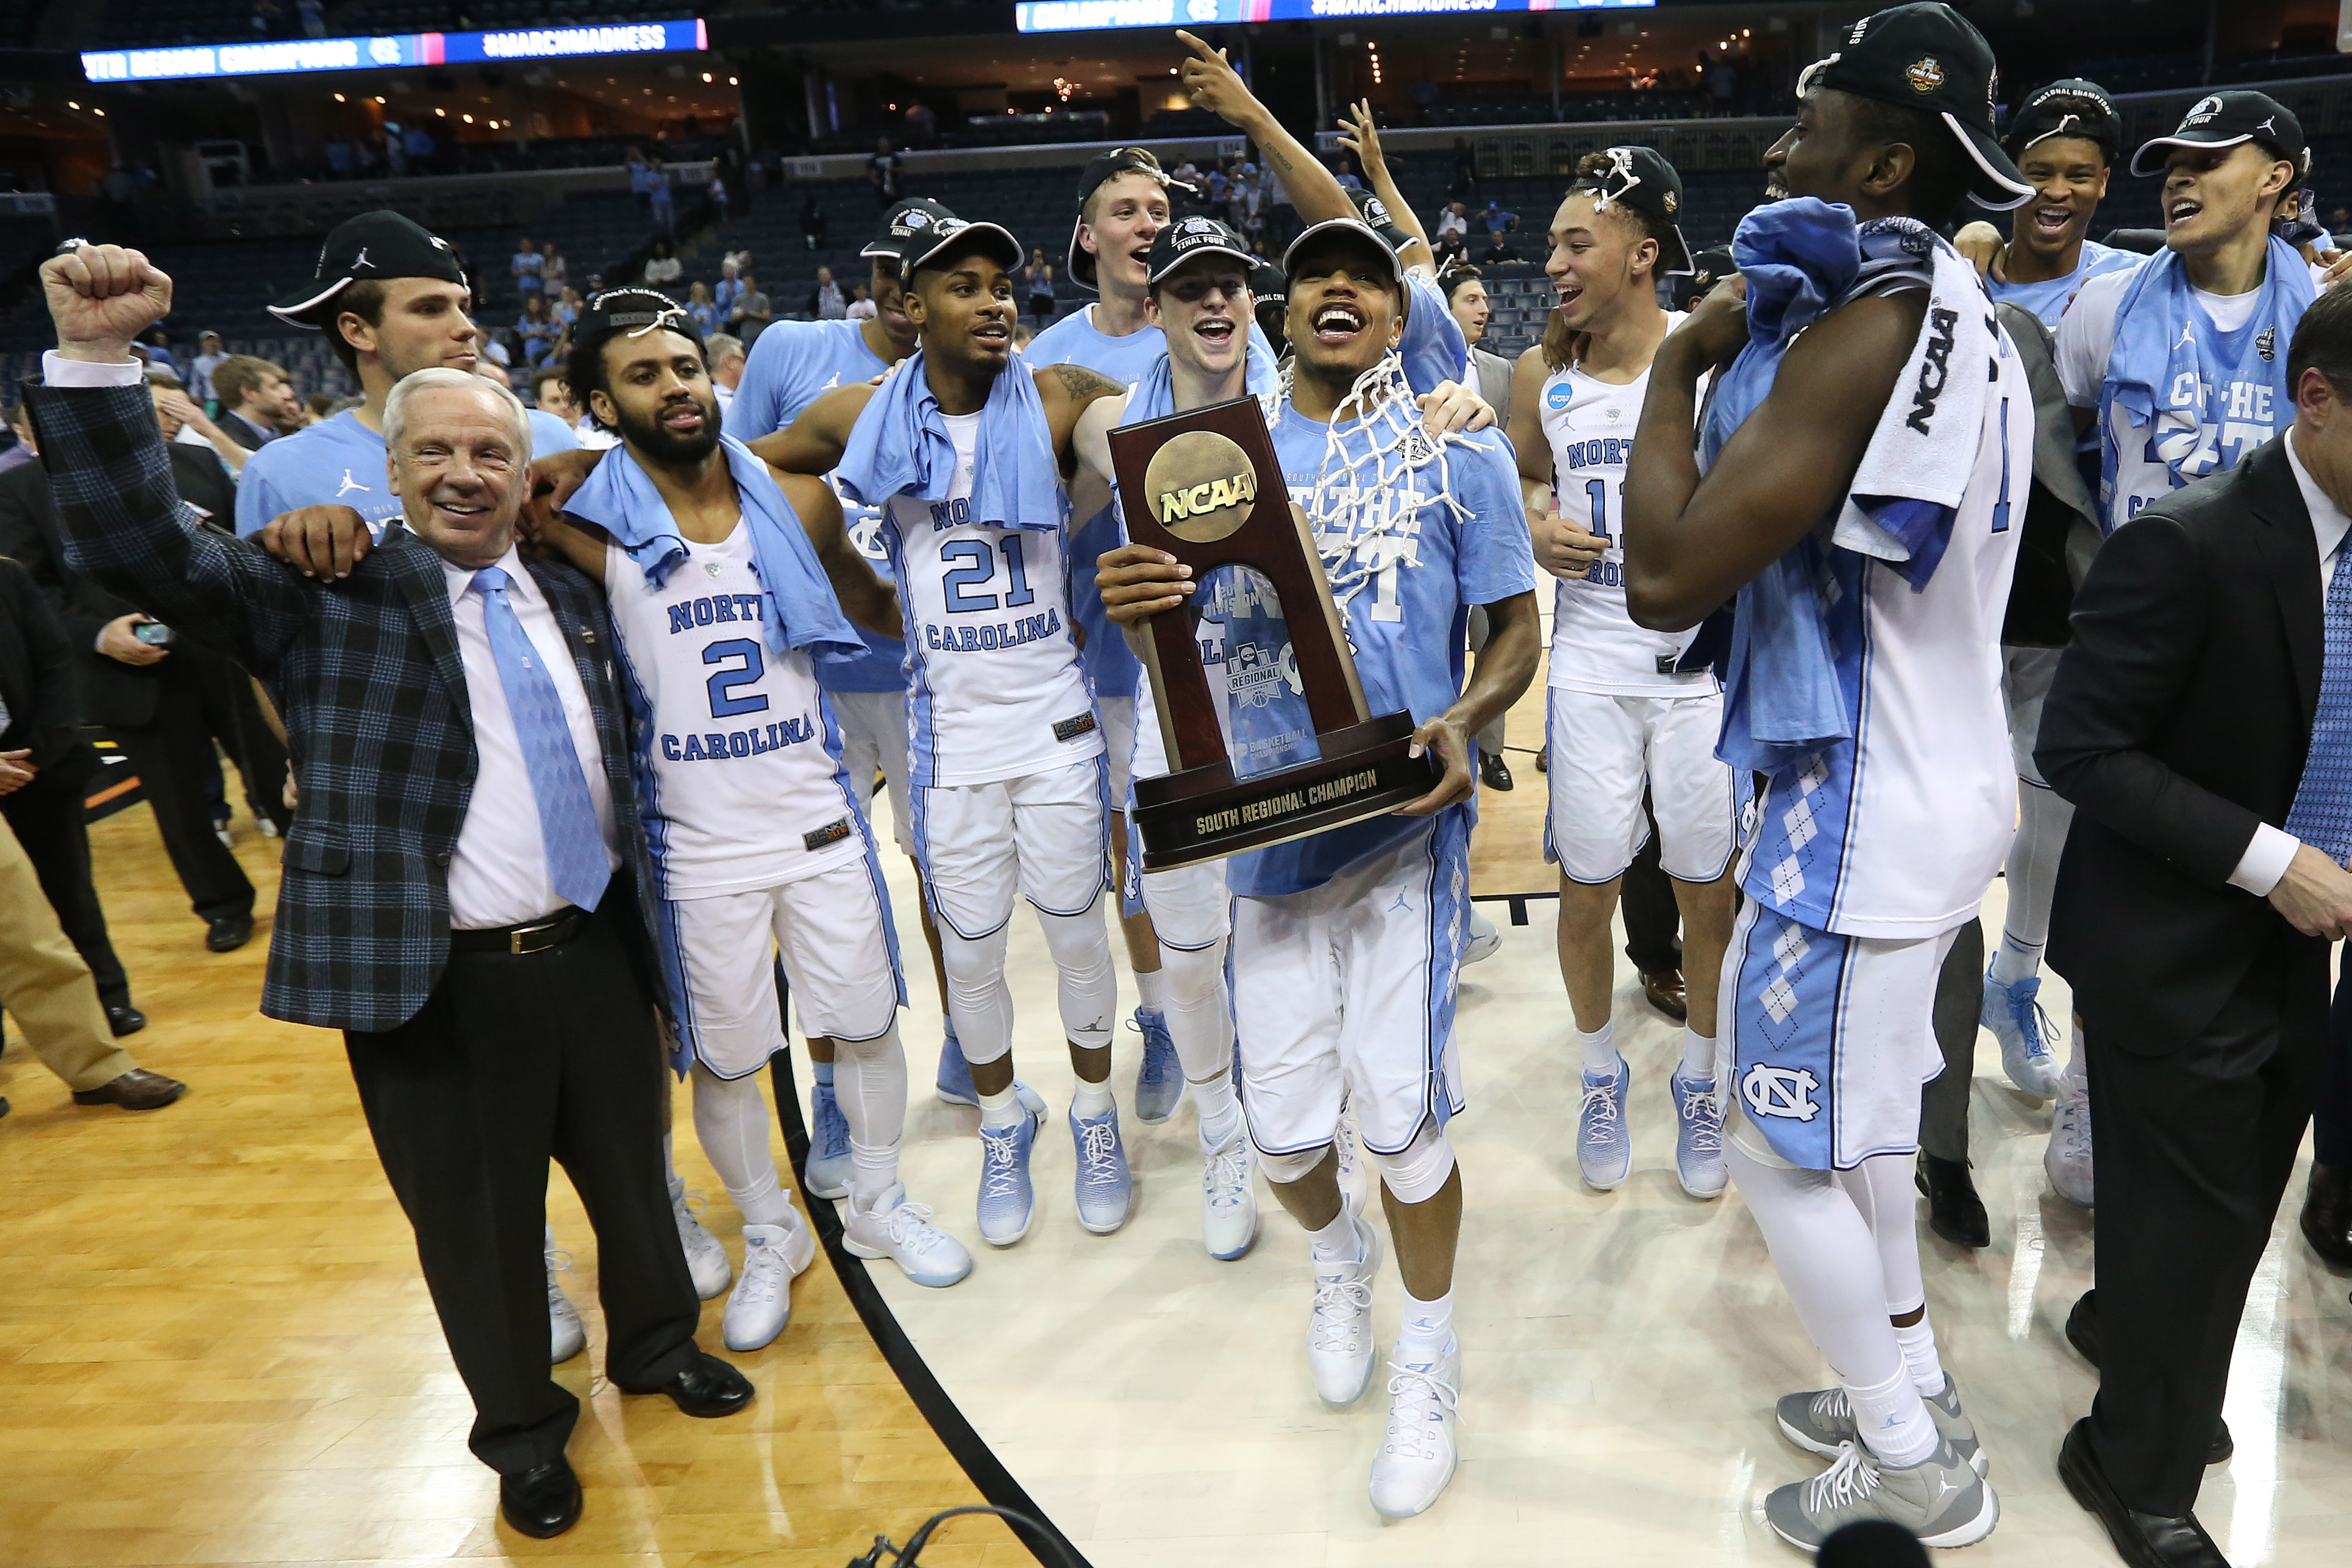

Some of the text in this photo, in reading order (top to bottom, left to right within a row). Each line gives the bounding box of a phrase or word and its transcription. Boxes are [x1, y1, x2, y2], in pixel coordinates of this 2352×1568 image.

[130, 48, 215, 77] REGION
[219, 40, 358, 73] CHAMPIONS
[483, 24, 666, 59] #MARCHMADNESS
[2033, 88, 2112, 115] REGIONAL CHAMPIONS
[1177, 236, 1225, 251] FINAL FOUR
[631, 288, 681, 310] CHAMPION
[1906, 307, 1959, 436] NCAA
[1286, 473, 1315, 482] SOUTH
[1161, 473, 1256, 524] NCAA
[940, 534, 1035, 614] 21
[667, 594, 764, 635] NORT
[925, 607, 1061, 653] CAROLINA
[702, 637, 770, 719] 2
[1232, 668, 1278, 688] REGIONAL
[660, 713, 815, 761] CAROLINA
[1249, 729, 1308, 754] BASKETBALL
[1196, 769, 1377, 835] SOUTH REGIONAL CHAMPION
